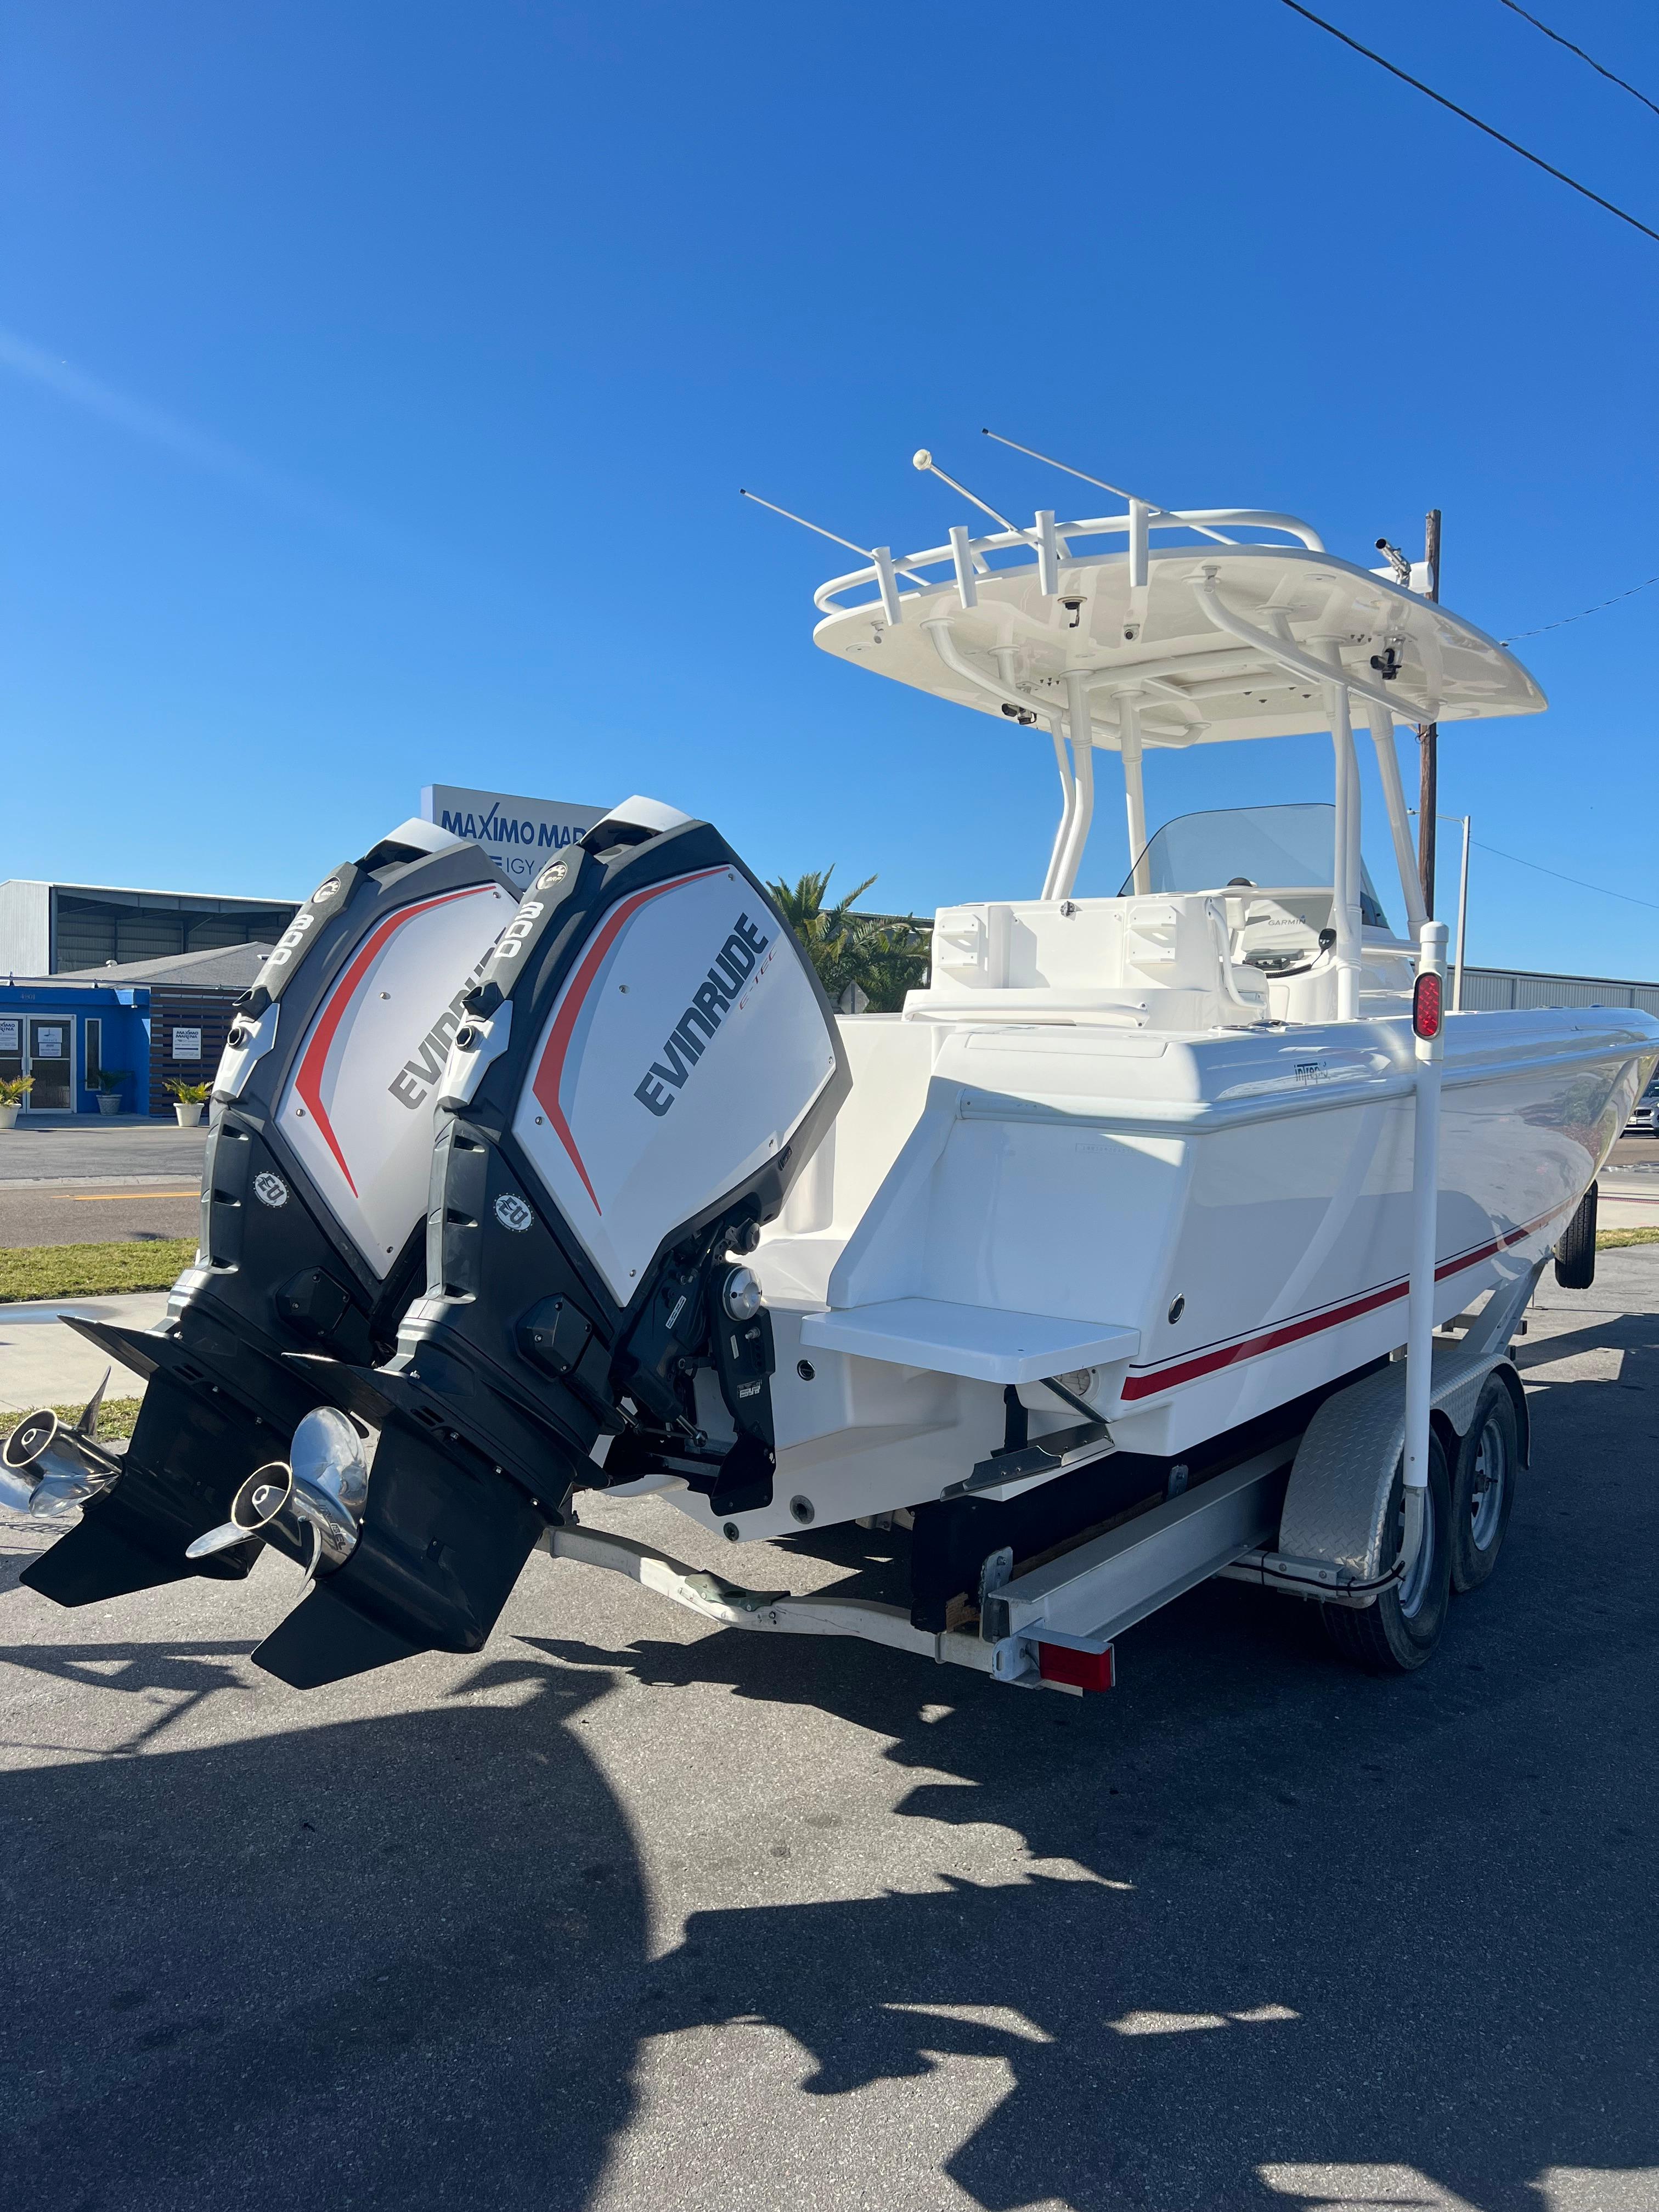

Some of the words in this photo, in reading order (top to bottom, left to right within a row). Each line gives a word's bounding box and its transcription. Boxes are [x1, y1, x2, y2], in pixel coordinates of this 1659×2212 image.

[442, 802, 534, 844] MAXIMO
[507, 857, 535, 875] IGY
[267, 914, 314, 965] 300
[494, 901, 544, 958] 300
[739, 944, 777, 1010] E-TEC
[634, 912, 769, 1117] EVINRUDE
